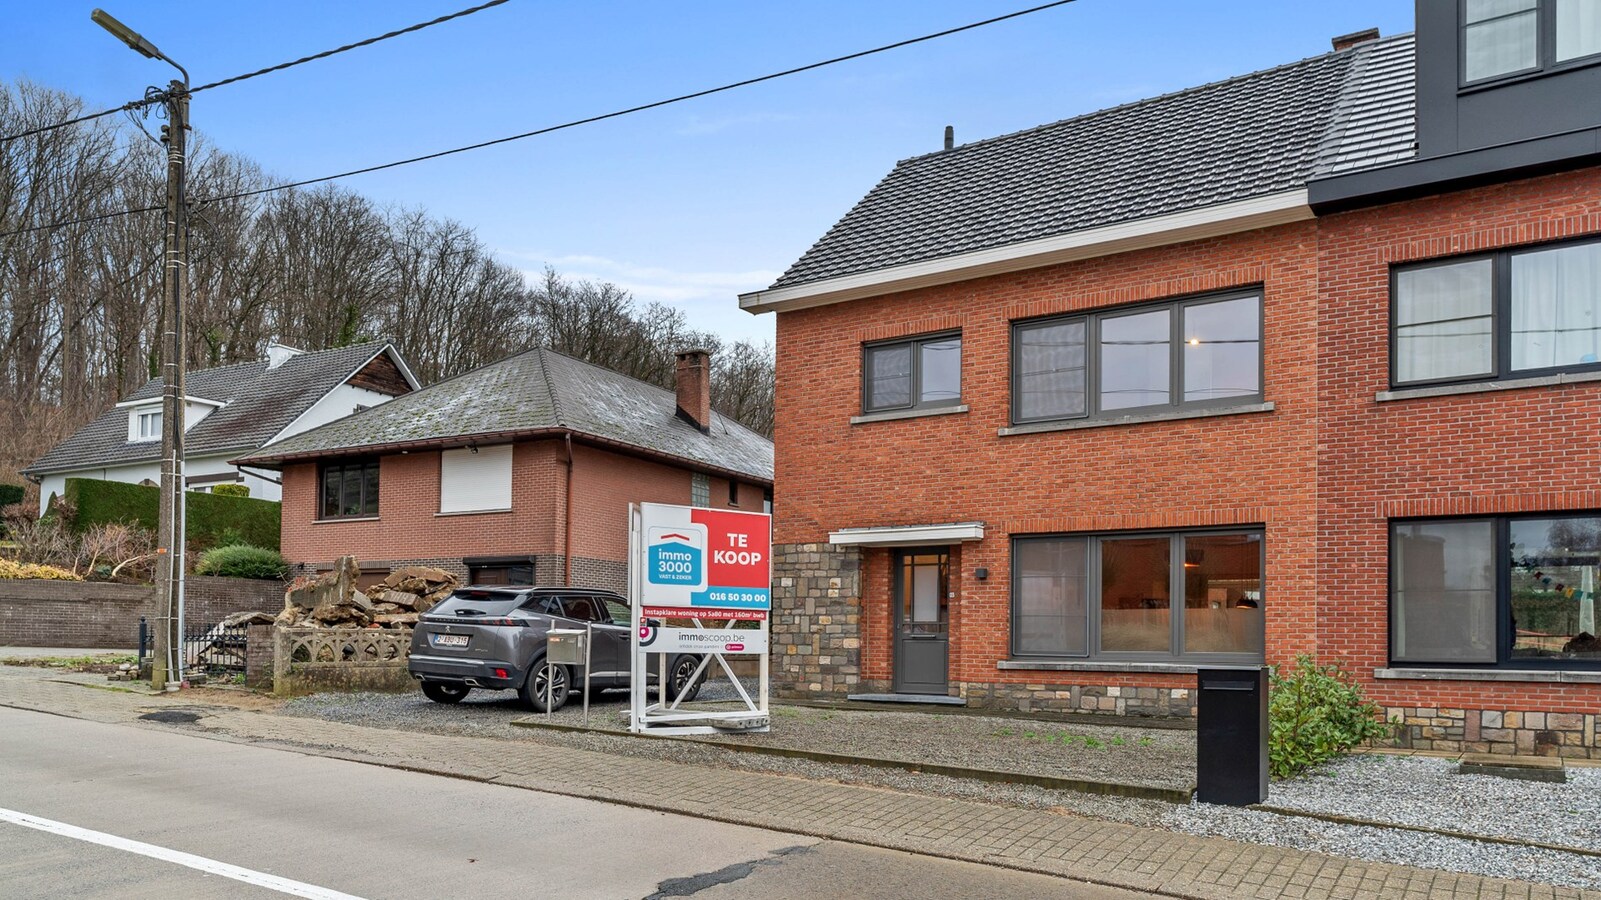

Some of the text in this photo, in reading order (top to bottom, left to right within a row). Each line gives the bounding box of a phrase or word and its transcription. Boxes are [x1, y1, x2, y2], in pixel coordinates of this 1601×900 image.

[727, 533, 748, 548] TE
[658, 548, 692, 561] immo
[714, 550, 762, 566] KOOP
[658, 561, 692, 573] 3000
[710, 592, 766, 602] 016 50 30 00
[644, 608, 677, 616] Instapklare
[678, 631, 745, 642] immoscoop.be
